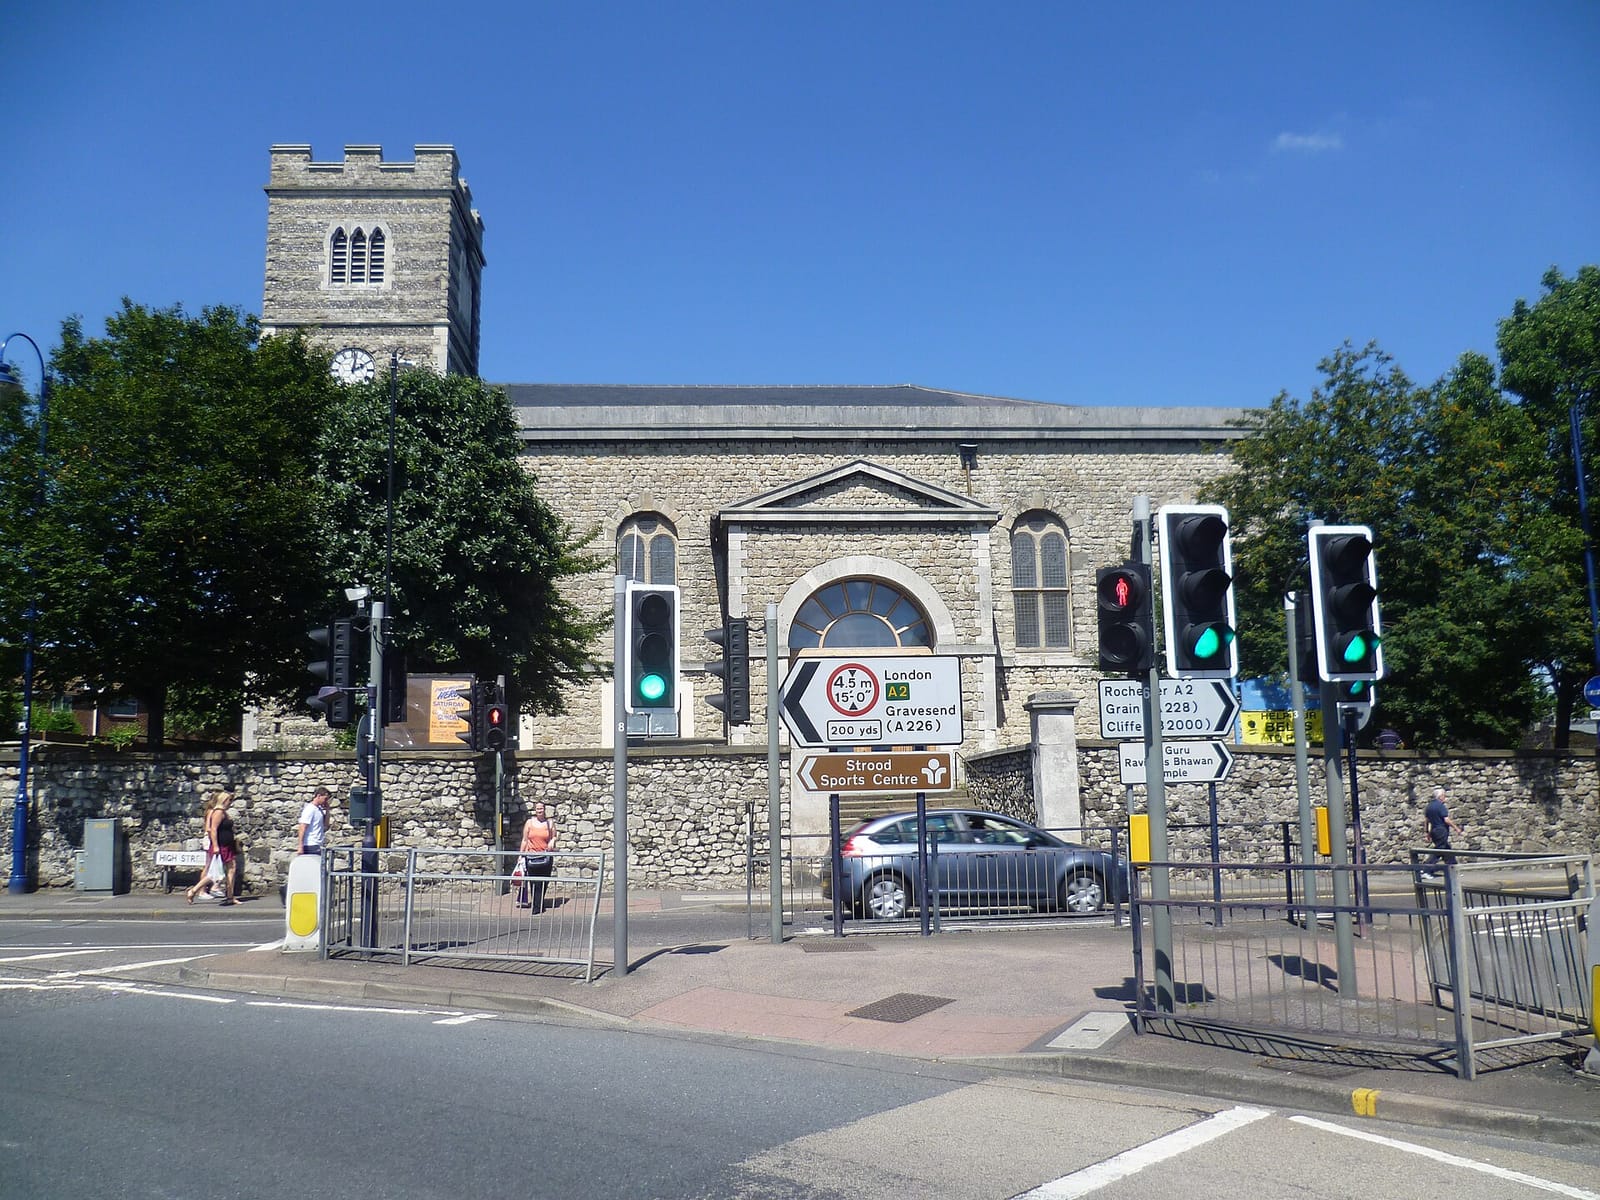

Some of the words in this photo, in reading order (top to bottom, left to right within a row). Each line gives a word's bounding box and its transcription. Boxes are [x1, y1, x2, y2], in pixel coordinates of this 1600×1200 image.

[884, 670, 932, 681] London
[833, 676, 856, 688] 4.5
[861, 680, 872, 688] m
[888, 686, 908, 697] A2
[1104, 686, 1168, 697] Rocheer
[1175, 685, 1193, 695] A2
[886, 704, 956, 717] Gravesend
[1106, 703, 1140, 714] Grain
[1160, 702, 1198, 714] 228)
[1261, 712, 1288, 720] HELP
[617, 721, 625, 732] 8
[831, 726, 854, 735] 200
[860, 725, 878, 737] yds
[886, 719, 942, 733] (A226)
[1106, 721, 1142, 732] Cliffe
[1265, 721, 1313, 732] BELS
[1165, 746, 1190, 755] Guru
[846, 759, 892, 771] Strood
[1173, 757, 1213, 766] Bhawan
[820, 775, 865, 787] Sports
[873, 774, 918, 785] Centre
[159, 854, 178, 862] HIGH
